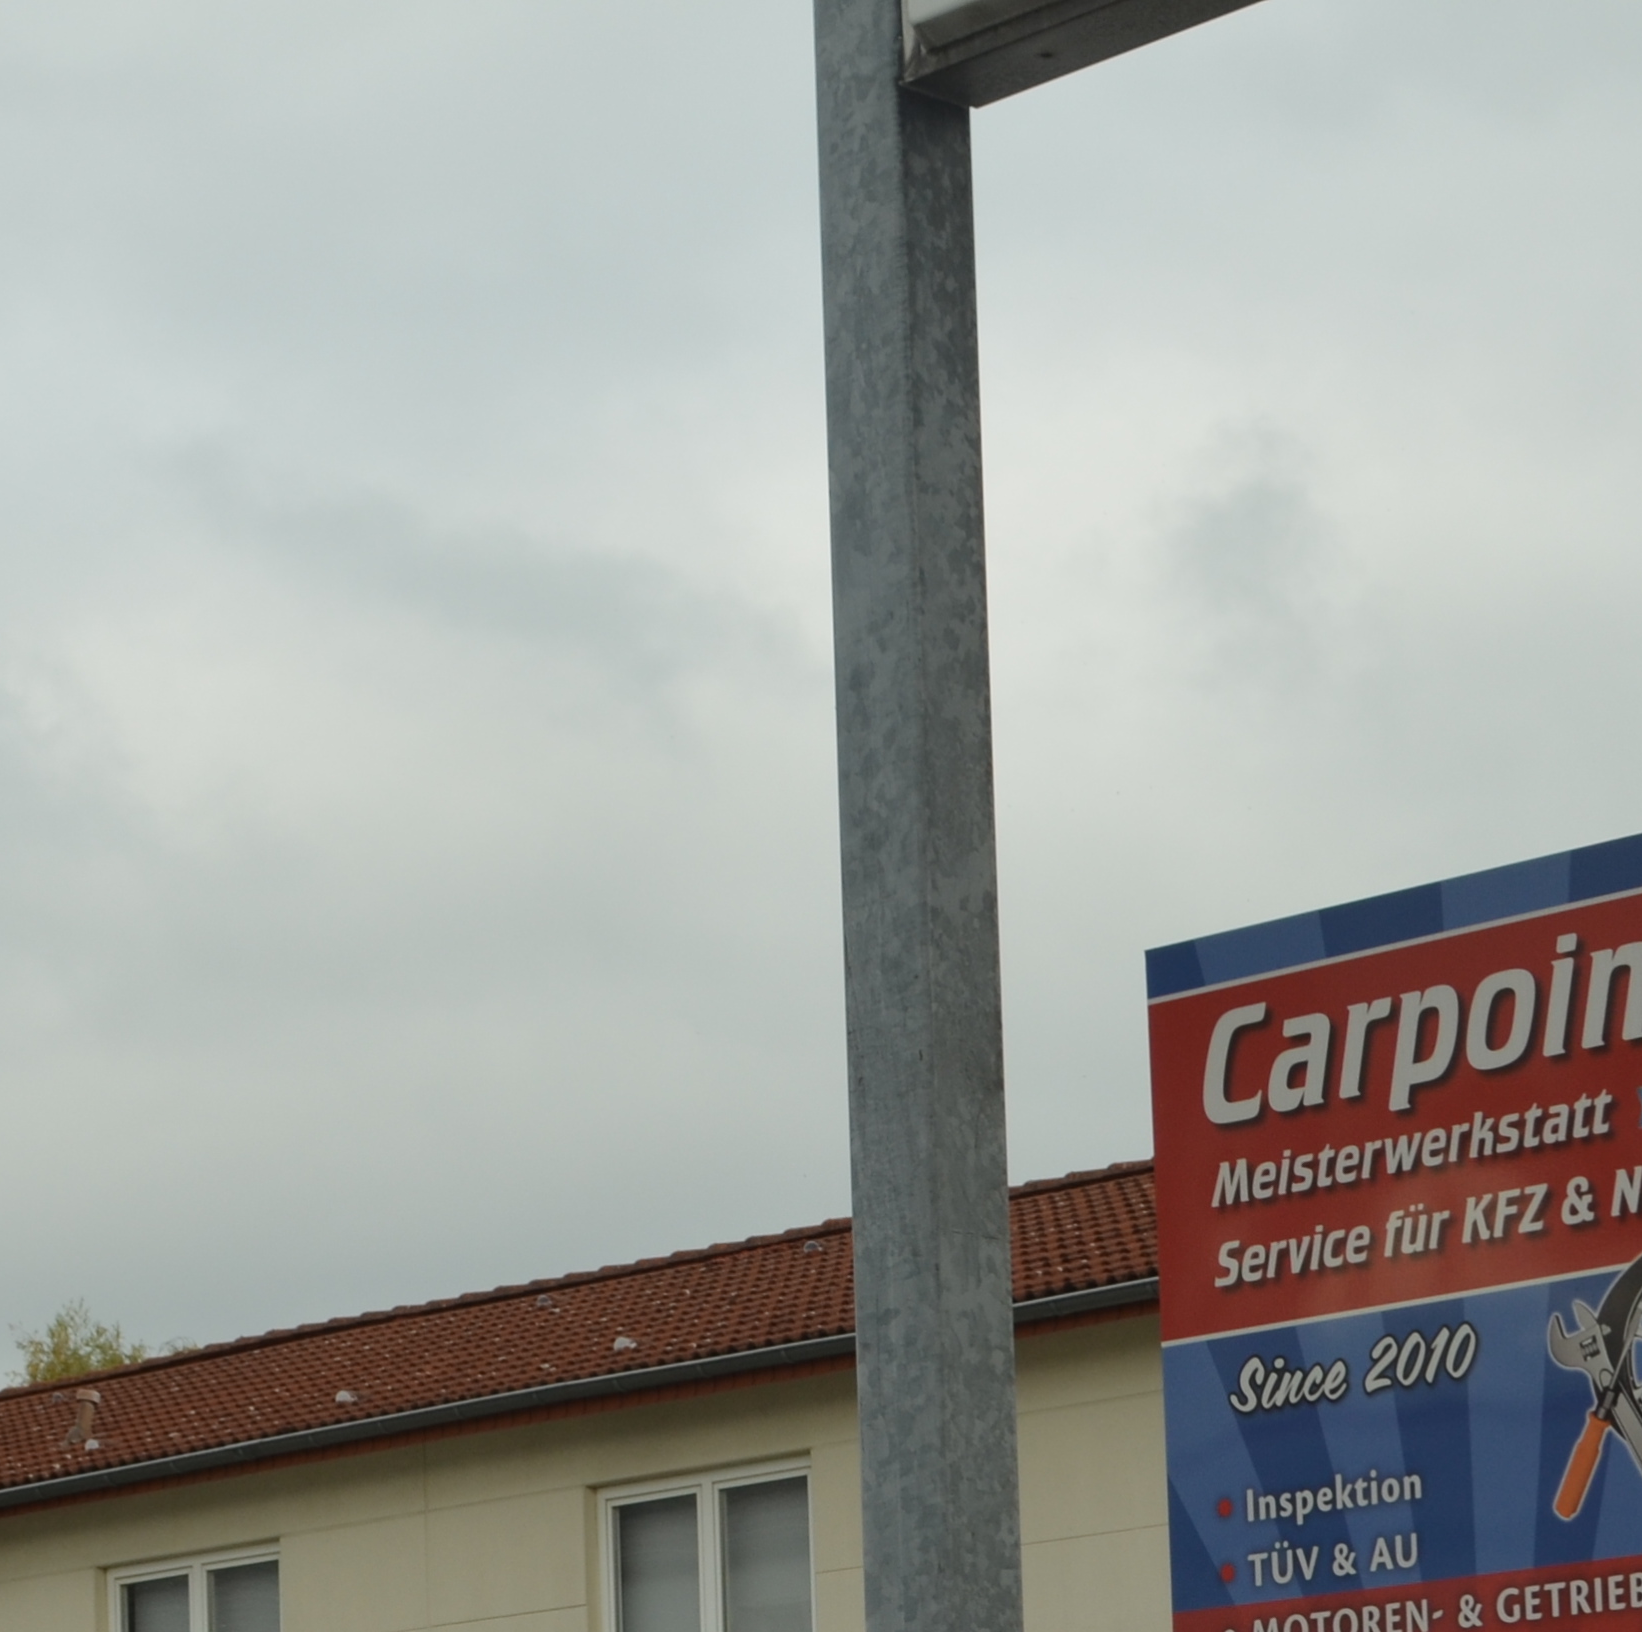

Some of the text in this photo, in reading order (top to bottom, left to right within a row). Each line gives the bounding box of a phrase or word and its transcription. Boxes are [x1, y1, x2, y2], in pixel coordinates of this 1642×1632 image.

[1211, 1088, 1612, 1208] Meisterwerkstatt
[1214, 1222, 1370, 1288] Service
[1384, 1204, 1450, 1258] für
[1462, 1183, 1548, 1244] KFZ
[1561, 1175, 1595, 1226] &
[1230, 1322, 1478, 1414] Since 2010
[1245, 1469, 1423, 1522] Inspektion
[1248, 1532, 1418, 1586] TÜV & AU
[1457, 1592, 1483, 1628] &
